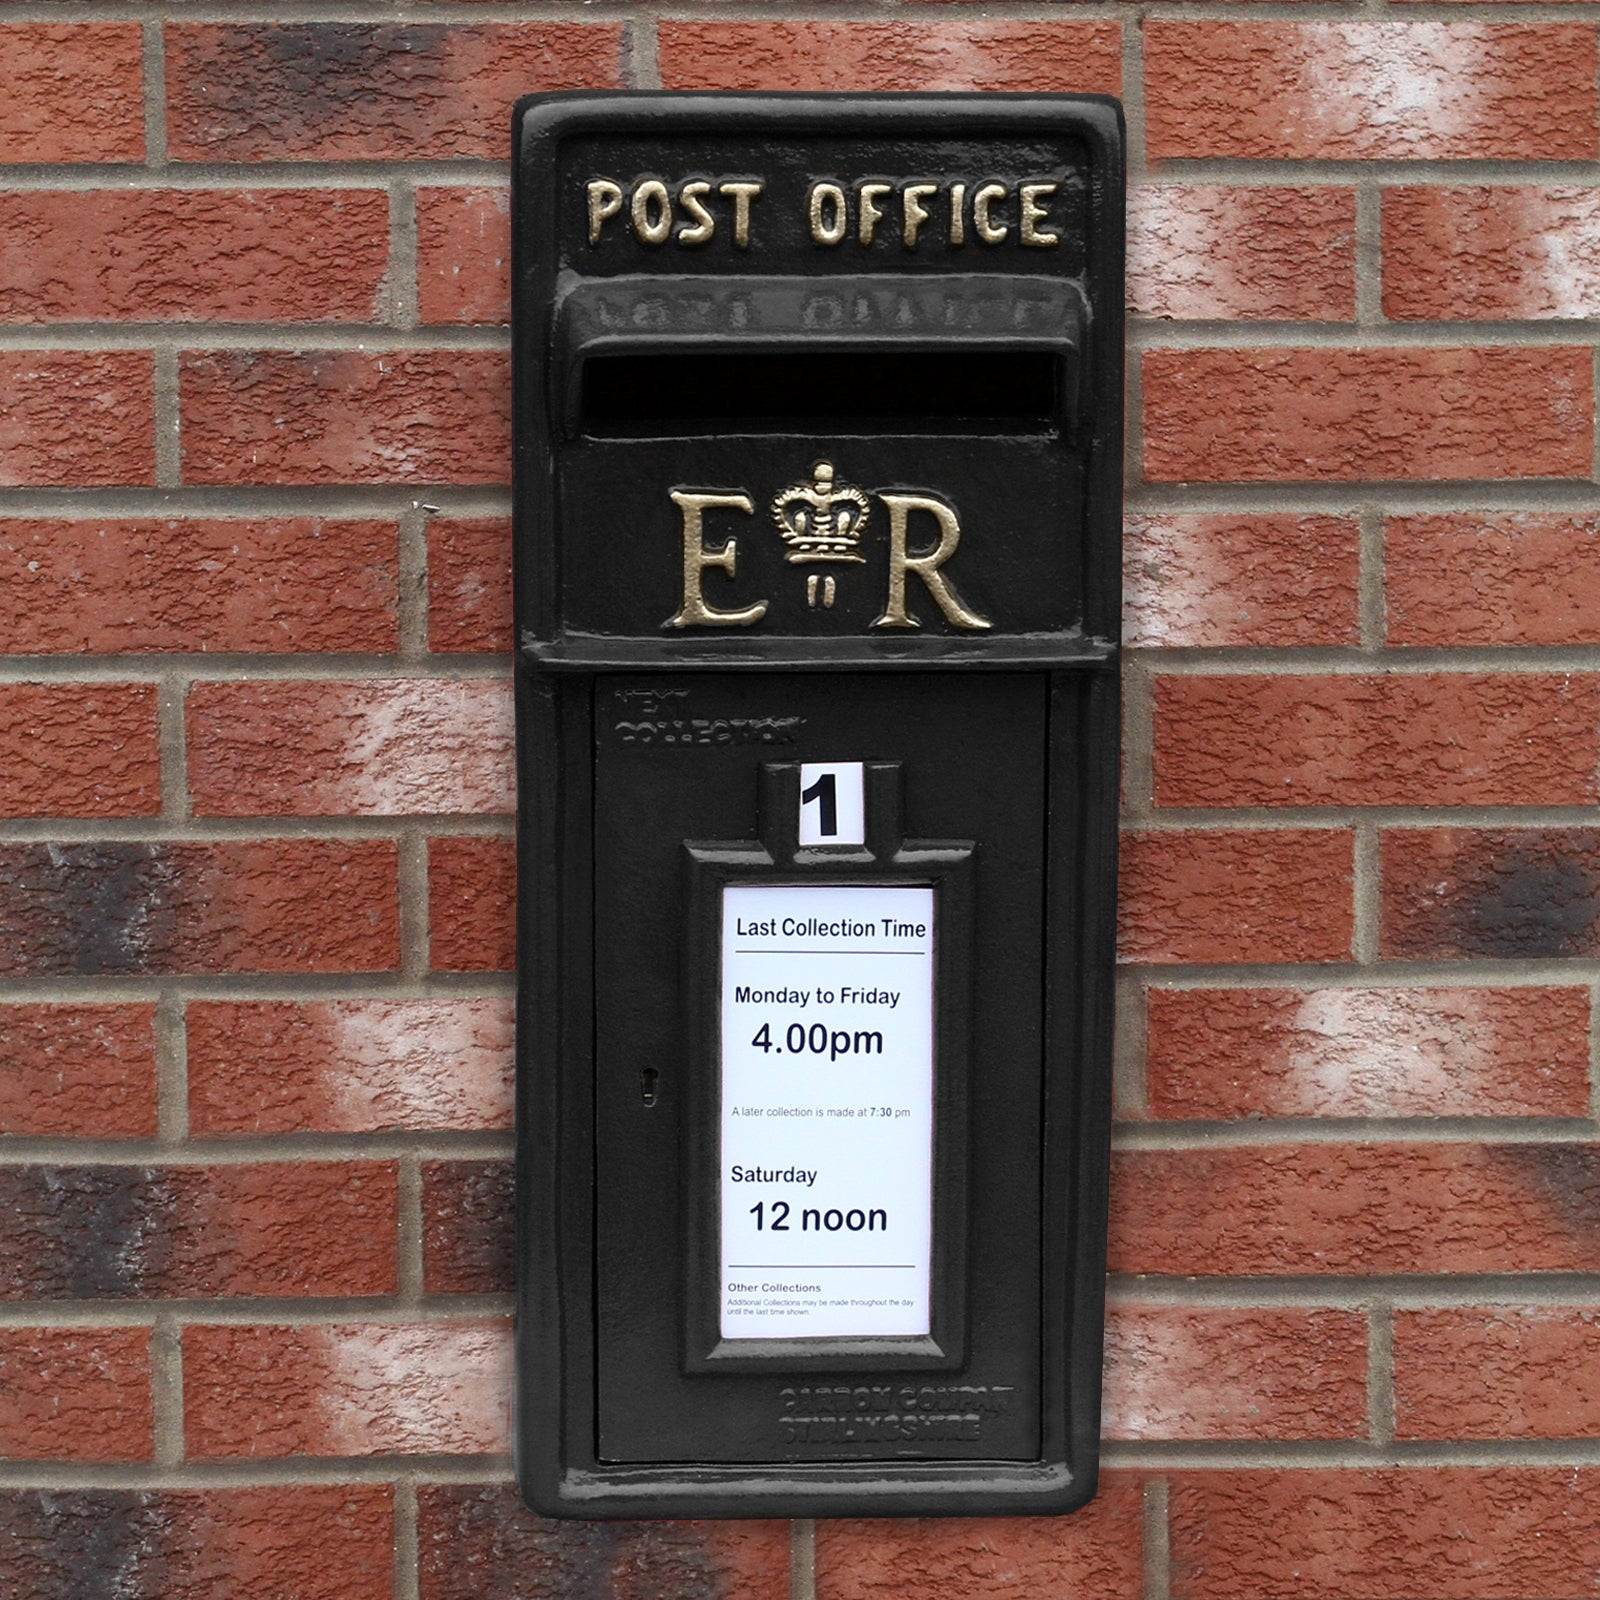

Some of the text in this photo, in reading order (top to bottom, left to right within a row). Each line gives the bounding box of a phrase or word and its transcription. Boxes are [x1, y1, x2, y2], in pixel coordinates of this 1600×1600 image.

[586, 179, 1060, 248] POST OFFICE
[664, 487, 993, 630] E R
[802, 774, 838, 837] 1
[736, 917, 927, 938] Last Collection Time
[735, 986, 901, 1009] Monday to Friday
[751, 1022, 883, 1063] 4.00pm
[731, 1106, 911, 1121] A later collection is made at 7:30 pm
[731, 1165, 818, 1188] Saturday
[749, 1200, 888, 1232] 12 noon
[727, 1283, 822, 1293] Other Collections
[727, 1298, 915, 1309] Additional Collections may be made throughout the day
[727, 1307, 742, 1316] until
[743, 1307, 755, 1316] the
[755, 1307, 769, 1316] last
[770, 1307, 786, 1316] time
